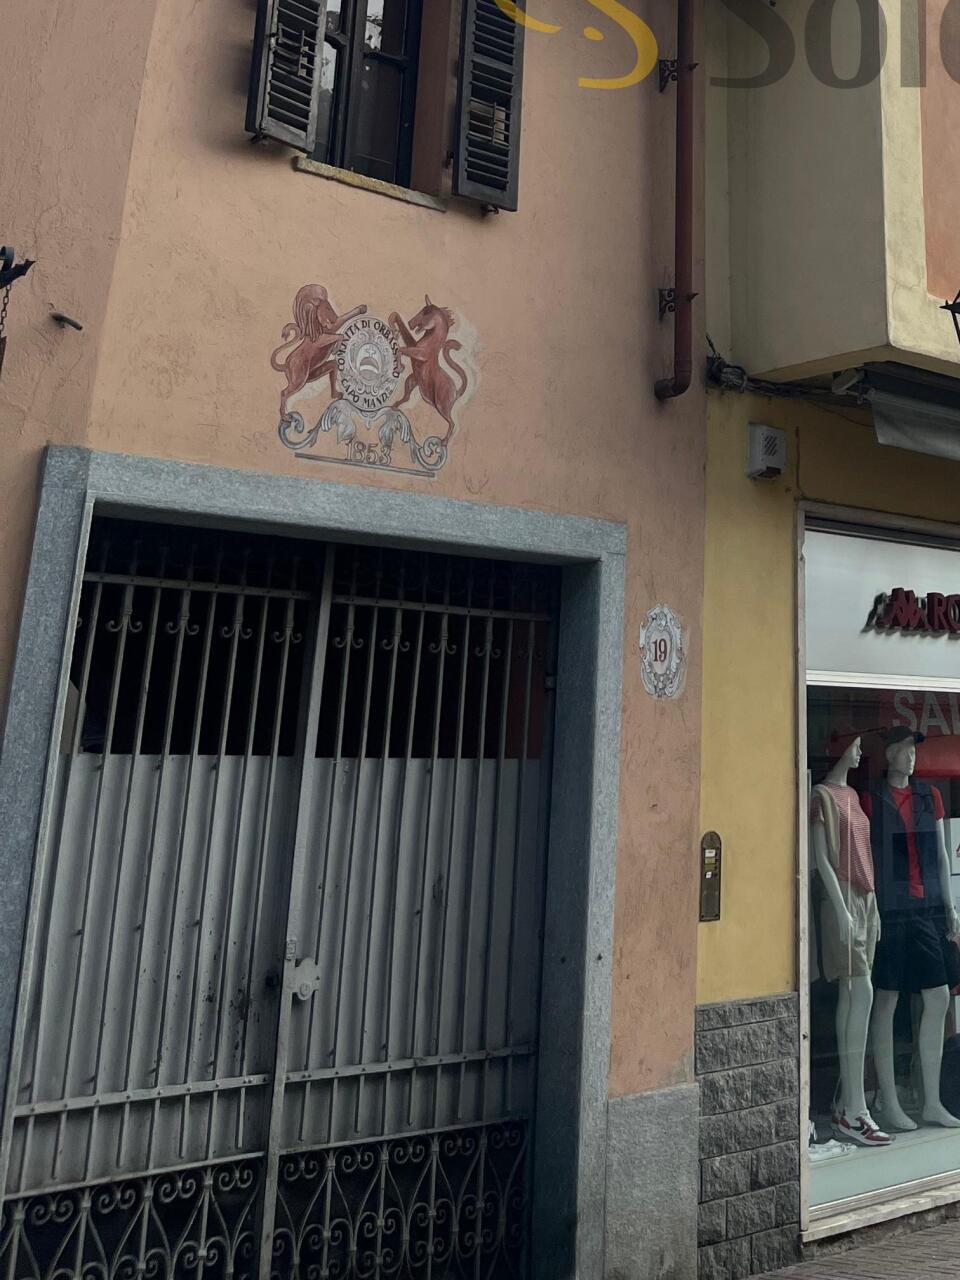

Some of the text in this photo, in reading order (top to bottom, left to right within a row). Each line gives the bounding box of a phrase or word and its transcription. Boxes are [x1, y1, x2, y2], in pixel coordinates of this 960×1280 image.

[361, 320, 371, 329] DI
[341, 378, 360, 403] CAPO
[345, 439, 392, 466] 1853
[651, 638, 668, 662] 19
